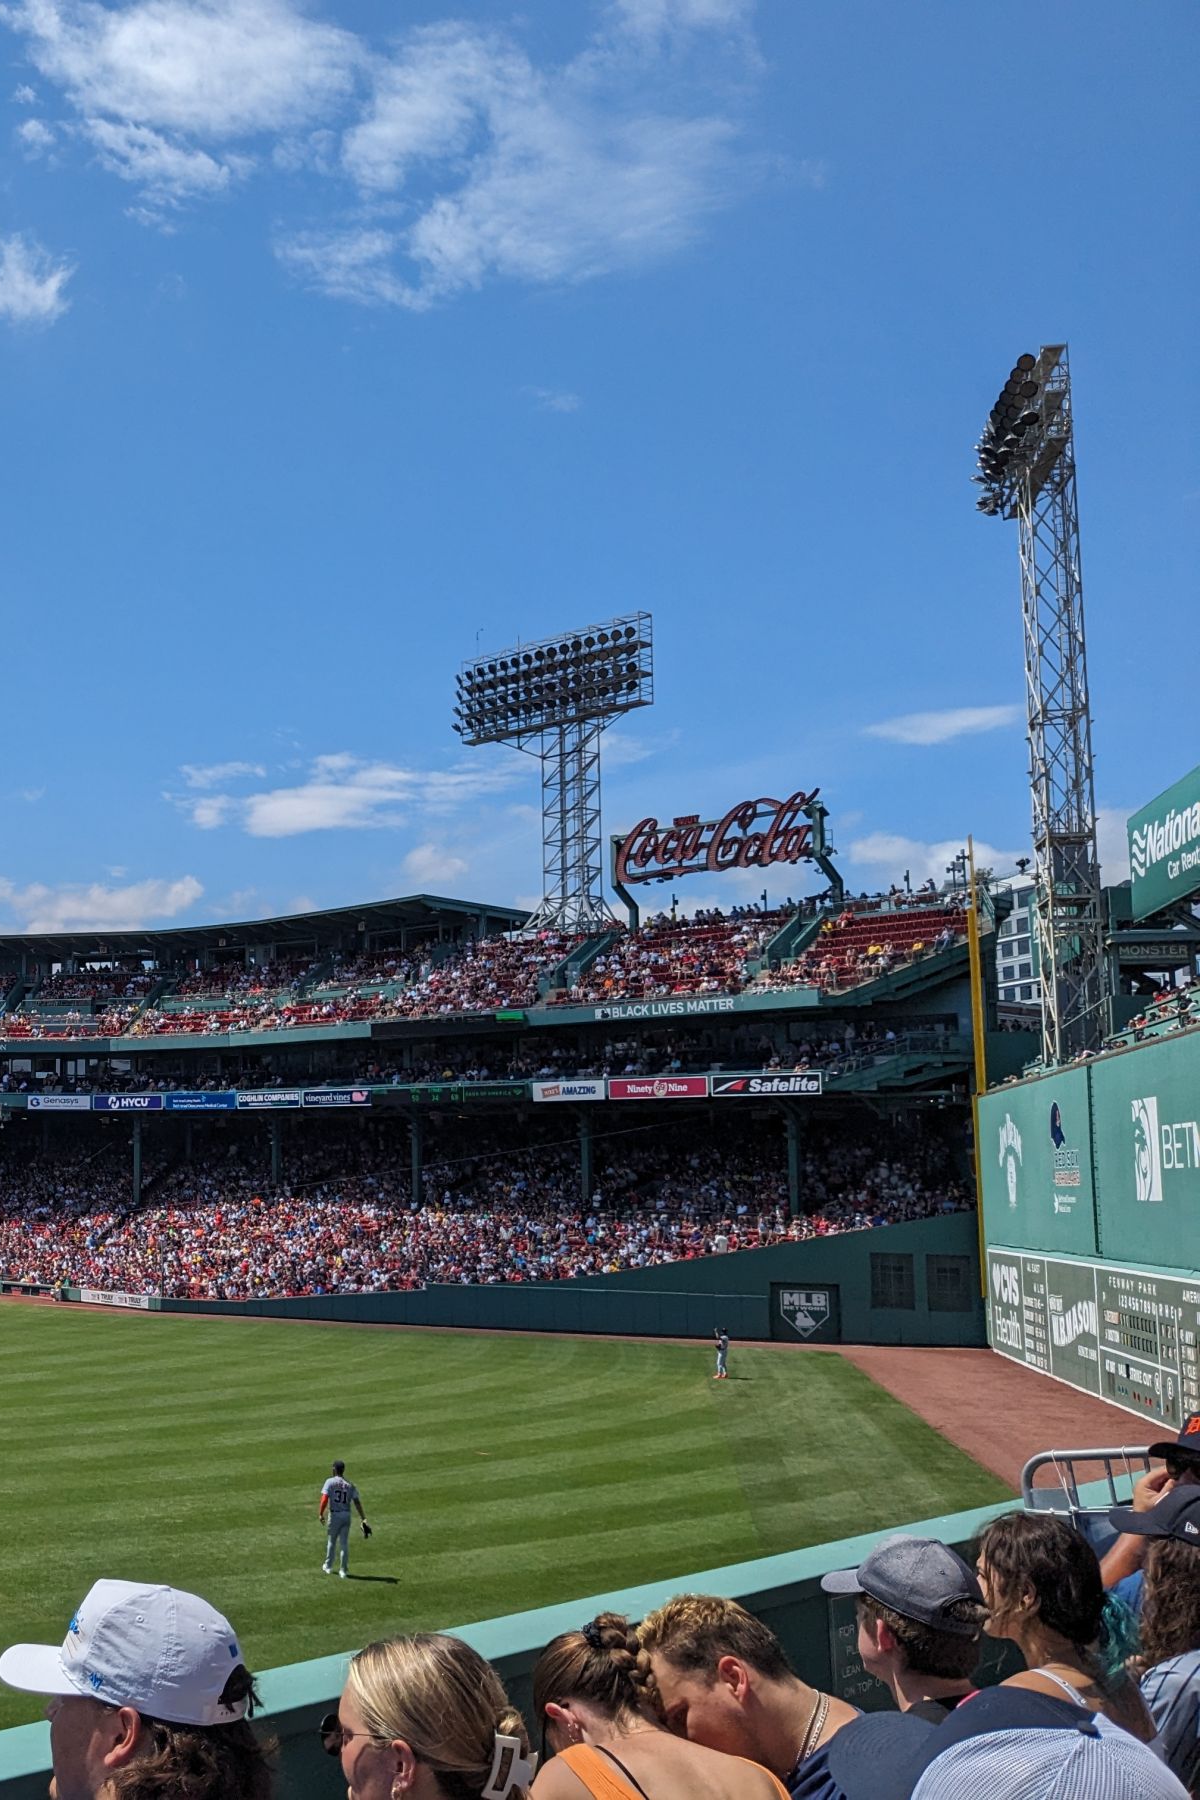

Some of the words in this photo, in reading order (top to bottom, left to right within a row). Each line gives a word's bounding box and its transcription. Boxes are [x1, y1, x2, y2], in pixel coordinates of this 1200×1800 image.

[615, 788, 820, 884] Coca-Cola
[1167, 860, 1180, 879] Car
[1119, 945, 1188, 955] MONSTER
[612, 1005, 649, 1018] BLACK
[651, 1002, 684, 1015] LIVES
[687, 999, 734, 1013] MATTER
[561, 1086, 596, 1096] AMAZING
[627, 1084, 653, 1094] Ninety
[668, 1083, 688, 1092] Nine
[749, 1077, 819, 1092] Safelite
[43, 1097, 79, 1105] Genasys
[121, 1097, 148, 1107] HYCU
[264, 1093, 298, 1102] COMPANIES
[305, 1094, 332, 1104] vineyard
[1000, 1265, 1020, 1306] CVS
[1108, 1276, 1134, 1292] FENWAY
[1138, 1281, 1157, 1296] PARK
[783, 1293, 826, 1306] MLB
[995, 1305, 1022, 1350] Health
[334, 1490, 348, 1504] 31
[839, 1624, 855, 1638] FOR
[841, 1665, 861, 1679] LEAN
[857, 1680, 873, 1695] TOP
